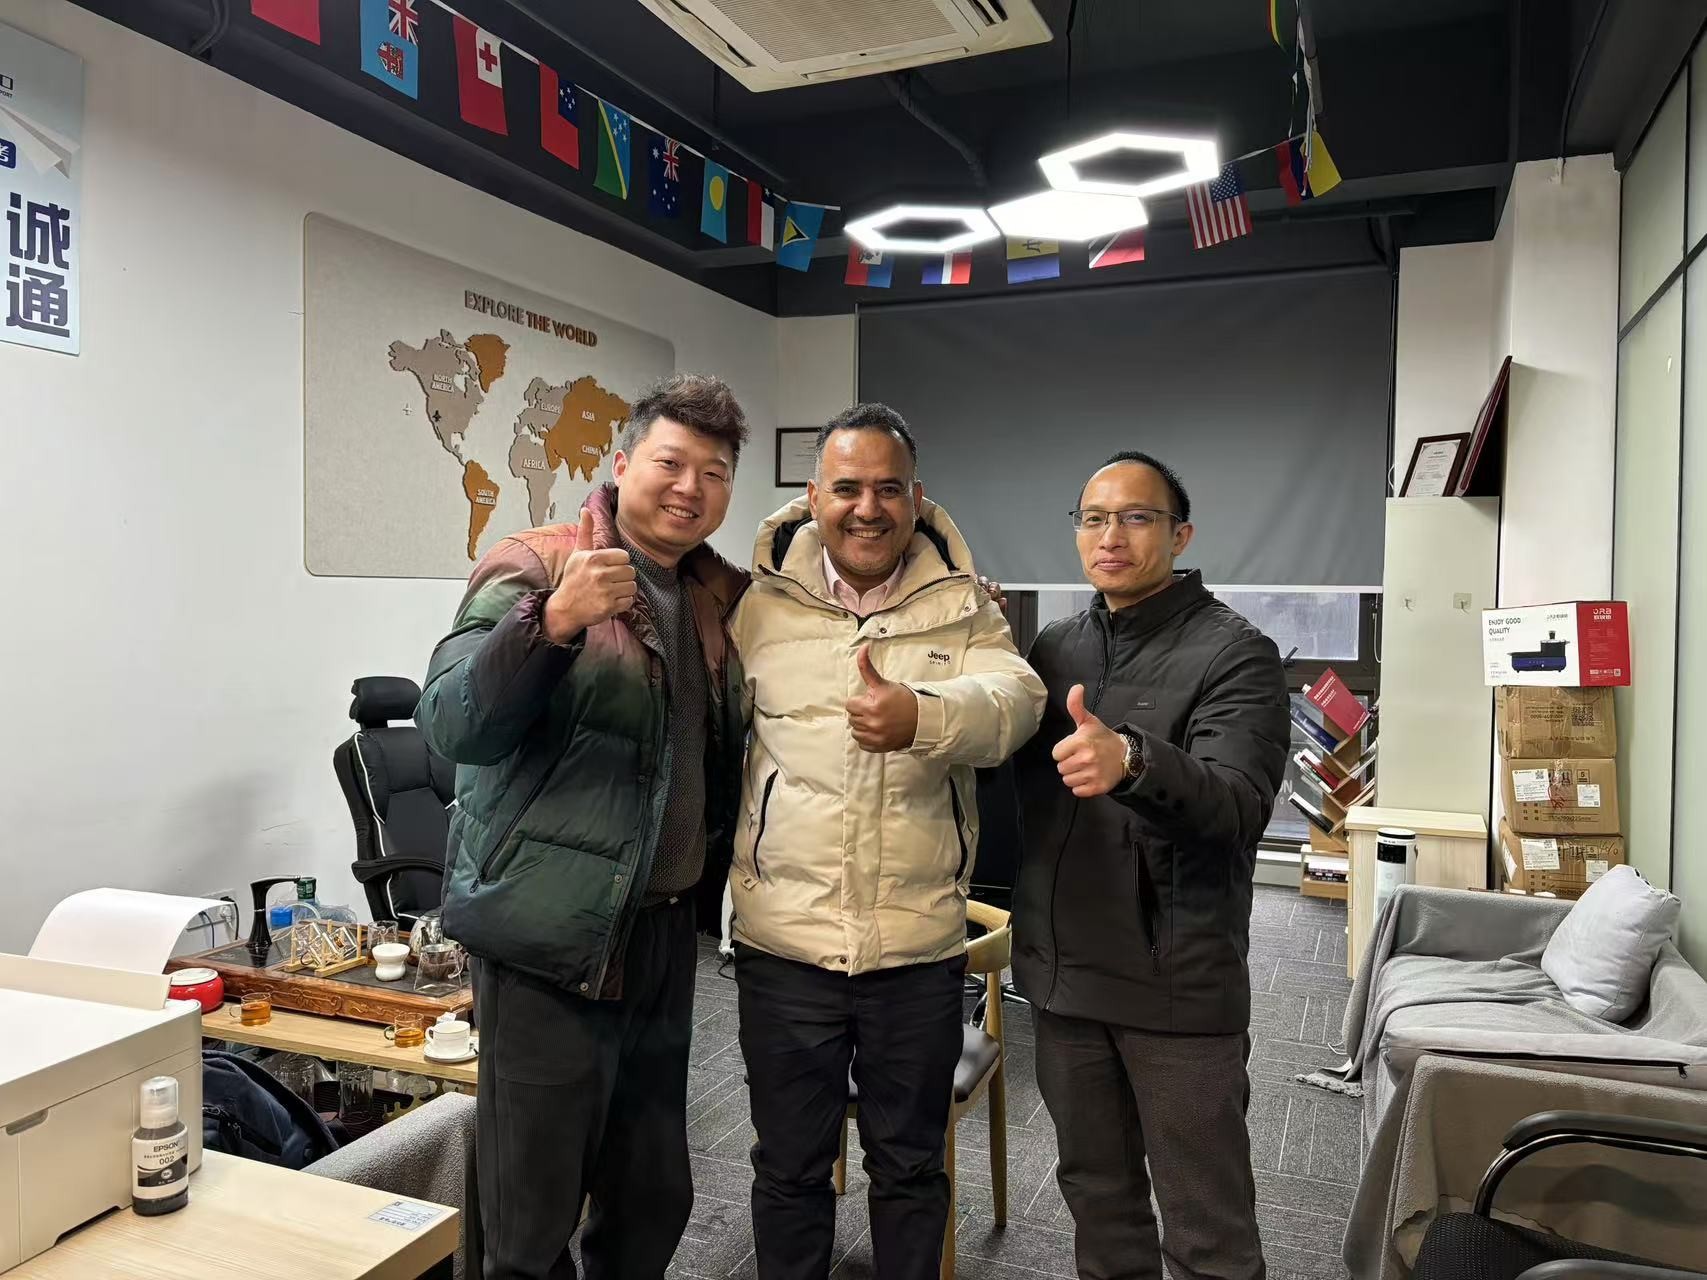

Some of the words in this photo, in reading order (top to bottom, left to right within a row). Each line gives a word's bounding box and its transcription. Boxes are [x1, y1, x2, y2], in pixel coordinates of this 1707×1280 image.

[464, 290, 524, 325] EXPLORE
[526, 311, 551, 333] THE
[552, 320, 598, 348] WORLD
[433, 374, 453, 383] NORTH
[432, 382, 454, 393] AMERICA
[540, 402, 561, 414] EUROPE
[581, 410, 595, 422] ASIA
[581, 445, 599, 456] CHINA
[523, 458, 546, 470] AFRICA
[477, 489, 495, 497] SOUTH
[475, 496, 496, 506] AMERICA
[1488, 618, 1504, 626] ENJOY
[1505, 617, 1521, 625] GOOD
[1488, 627, 1510, 635] QUALITY
[928, 650, 950, 661] Jeep
[154, 1142, 179, 1152] EPSON
[159, 1155, 175, 1165] 002
